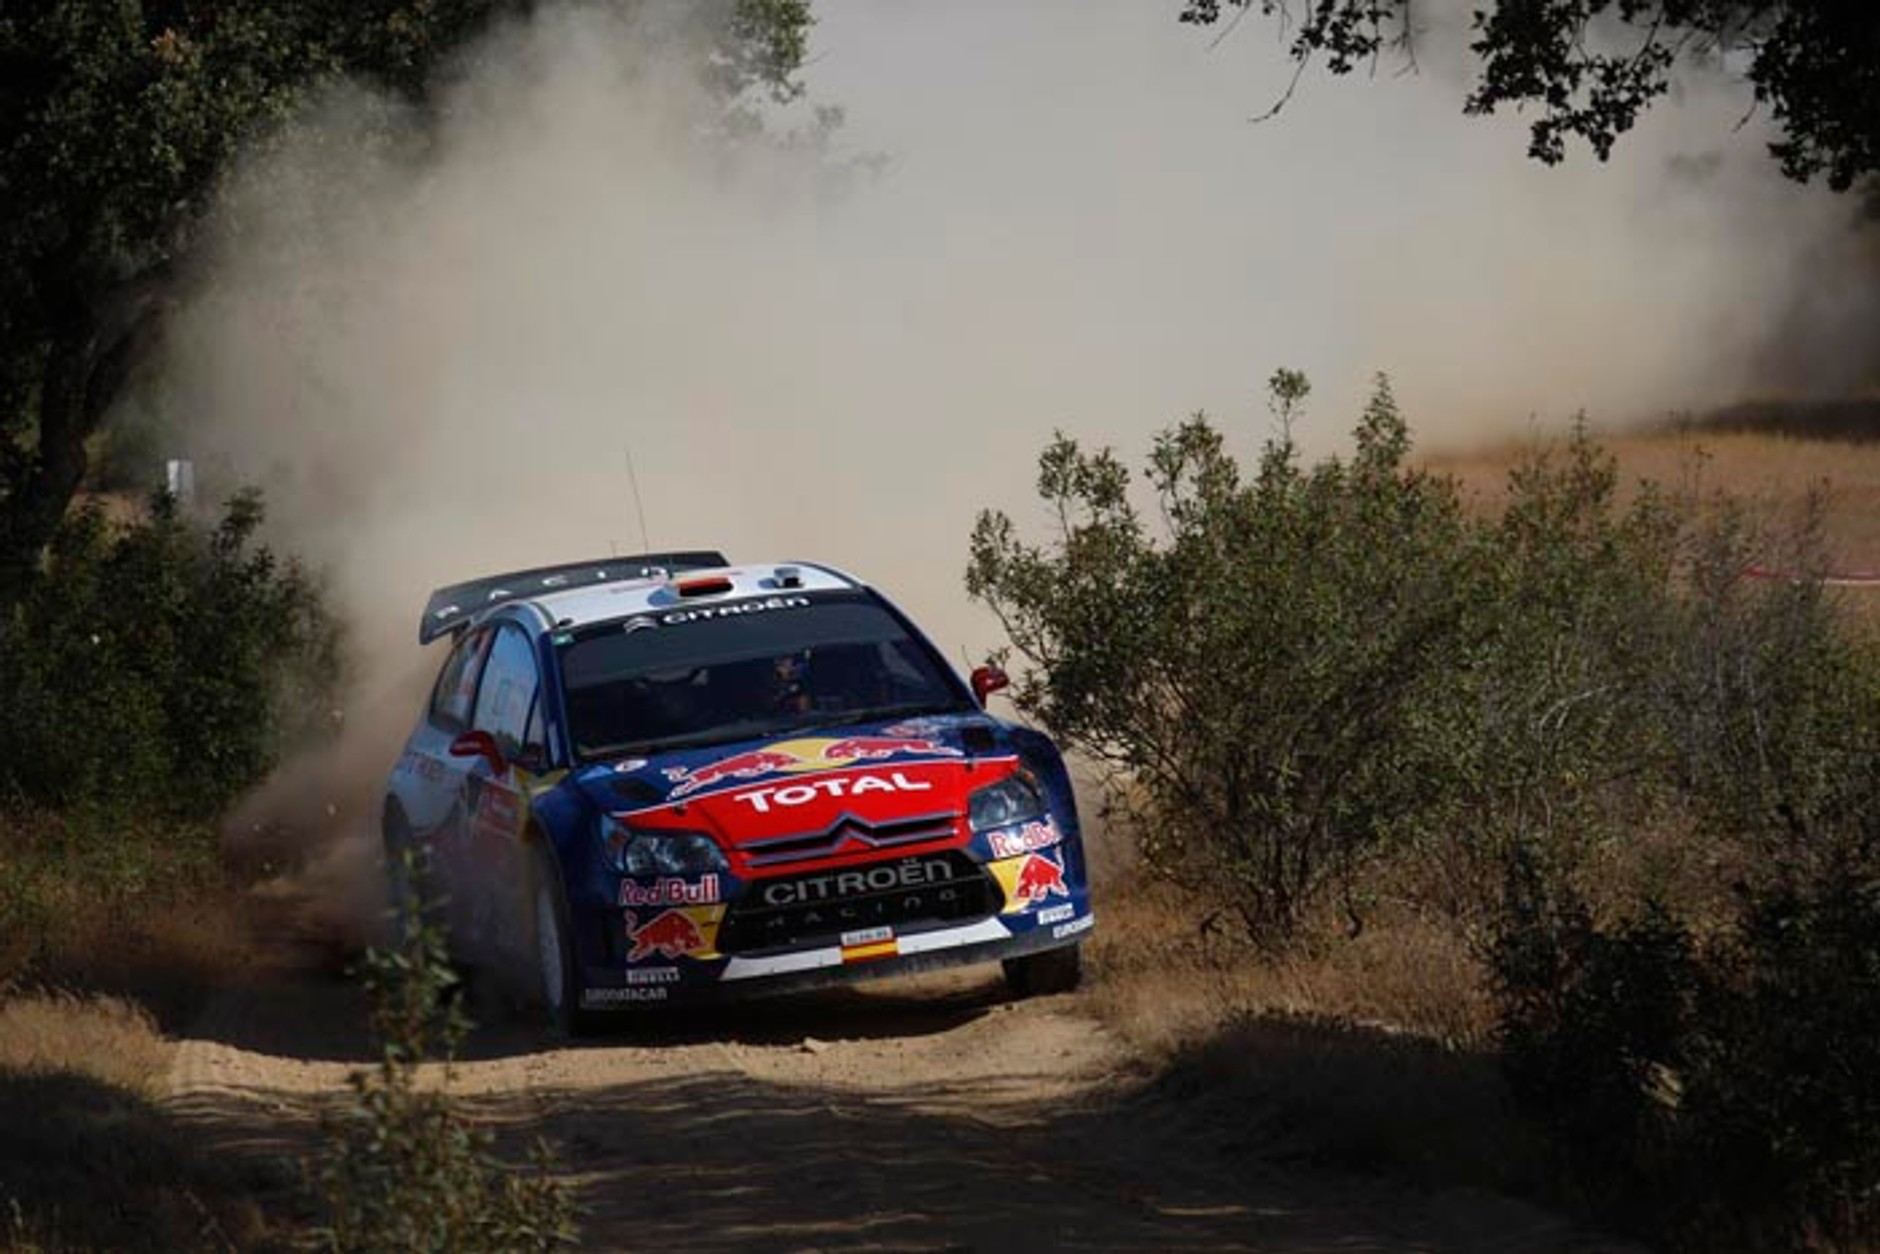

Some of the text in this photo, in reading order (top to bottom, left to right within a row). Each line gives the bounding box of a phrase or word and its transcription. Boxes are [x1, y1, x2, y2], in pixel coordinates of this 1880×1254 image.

[734, 772, 931, 812] TOTAL
[619, 872, 719, 906] Red Bull
